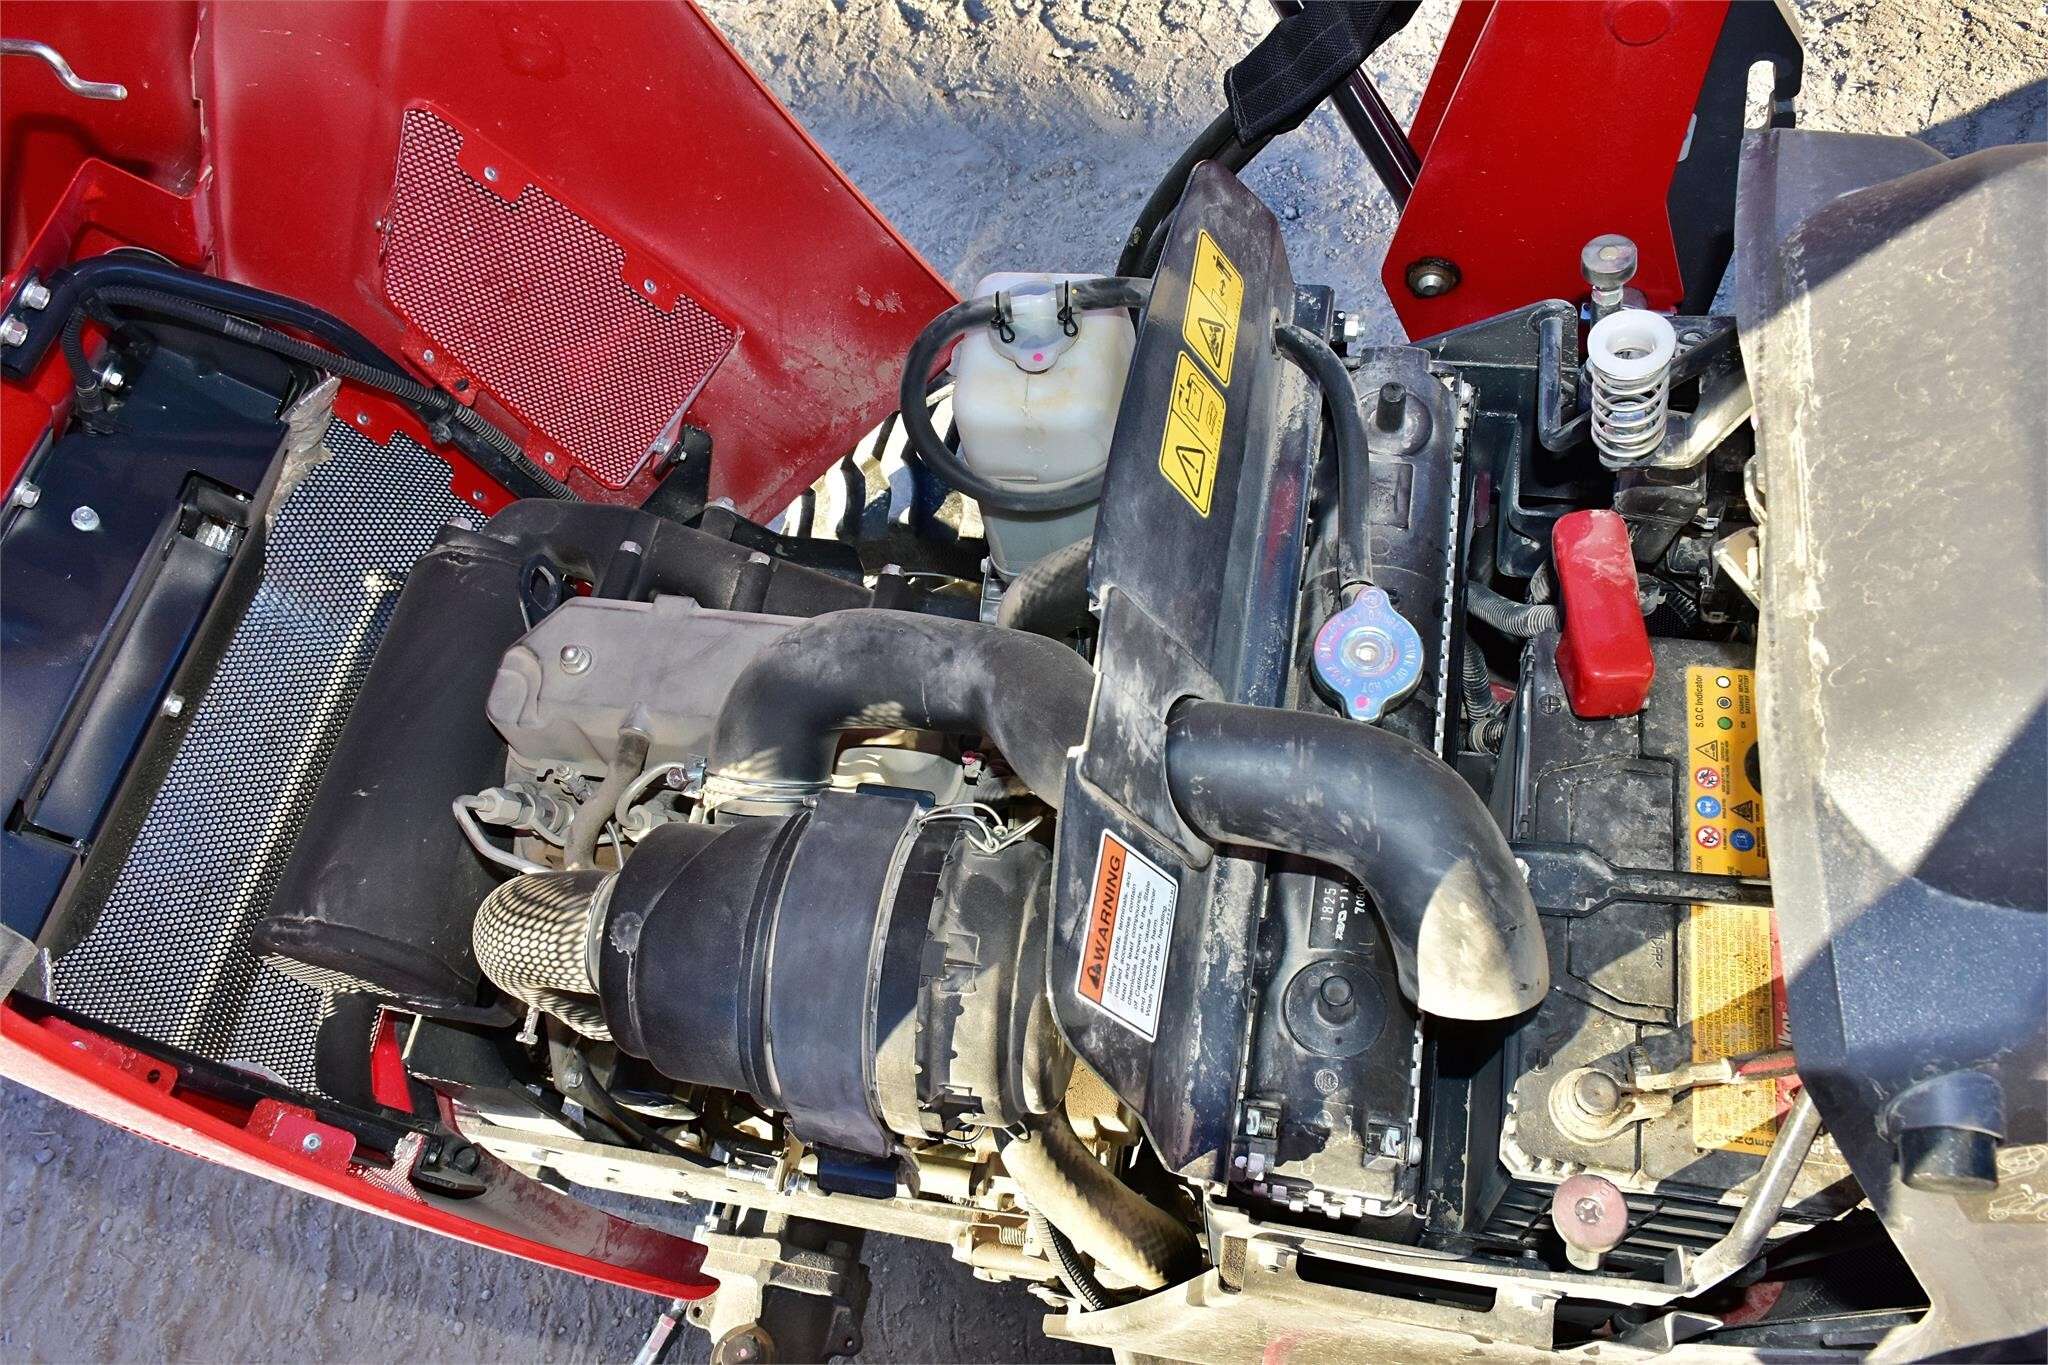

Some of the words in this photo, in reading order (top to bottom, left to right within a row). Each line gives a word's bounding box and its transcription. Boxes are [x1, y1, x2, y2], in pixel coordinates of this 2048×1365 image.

[1694, 674, 1704, 706] Indicator
[1094, 855, 1120, 961] WARNING
[1320, 887, 1336, 921] 1825
[1114, 968, 1123, 999] related
[1121, 917, 1131, 965] accessories
[1129, 883, 1137, 914] contain
[1128, 964, 1137, 1006] chemicals
[1135, 958, 1145, 997] California
[1144, 944, 1154, 994] reproductive
[1145, 994, 1153, 1017] Wash
